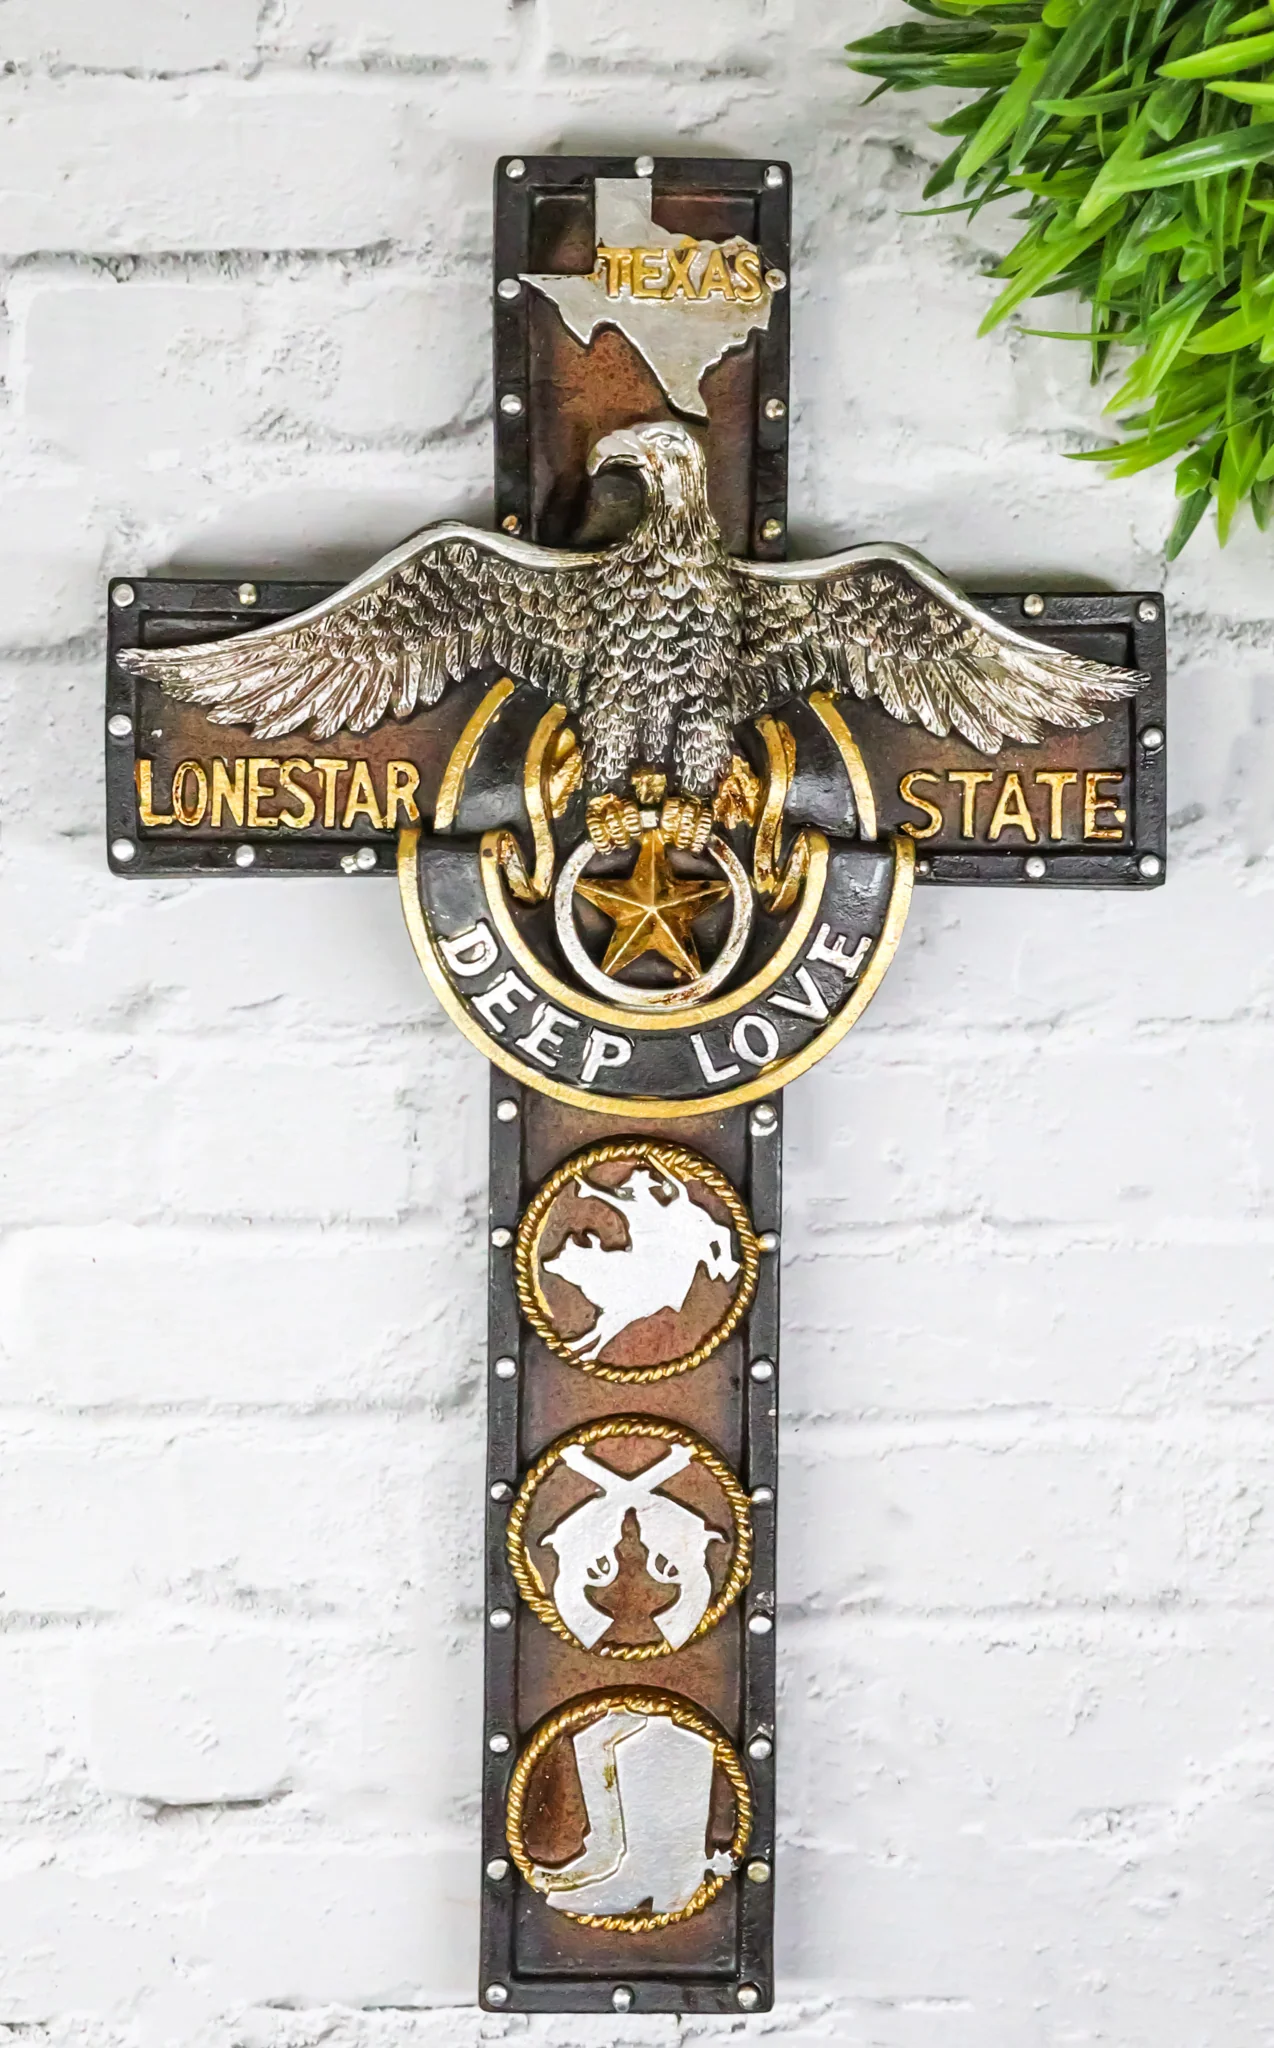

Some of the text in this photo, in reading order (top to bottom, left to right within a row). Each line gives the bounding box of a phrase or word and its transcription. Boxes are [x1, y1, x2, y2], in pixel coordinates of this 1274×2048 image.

[597, 247, 763, 301] TEXAS
[134, 758, 1123, 840] LONESTAR STATE
[437, 919, 873, 1083] DEEP LOVE
